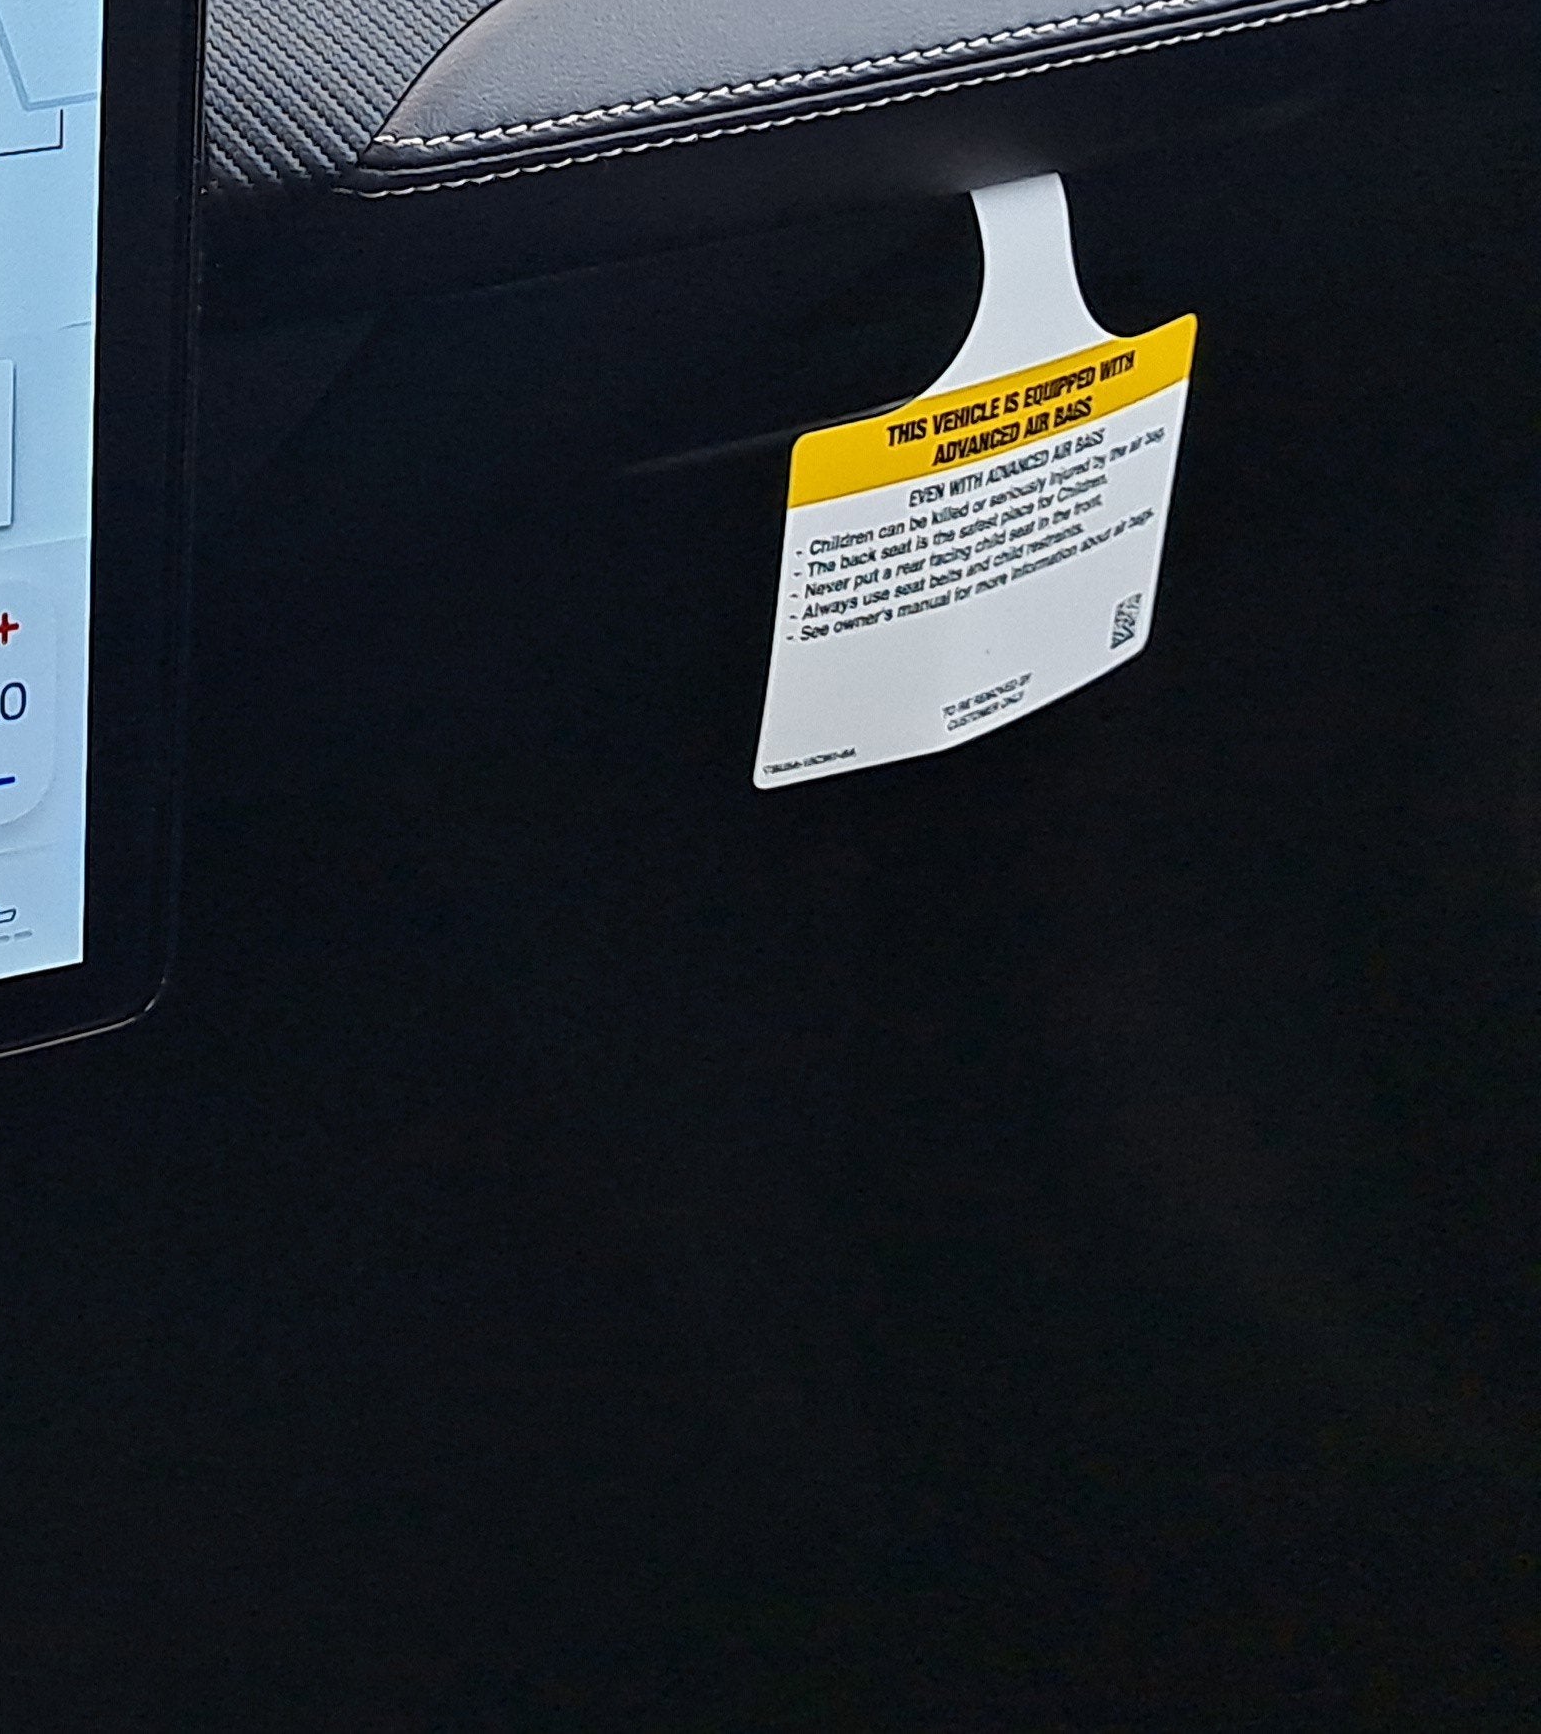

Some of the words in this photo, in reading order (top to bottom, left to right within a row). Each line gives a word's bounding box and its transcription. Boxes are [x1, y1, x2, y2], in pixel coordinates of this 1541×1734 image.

[887, 418, 927, 446] THIS
[932, 397, 1000, 434] VEHICLE
[1003, 391, 1019, 415] IS
[1023, 366, 1096, 408] EQUIPPED
[1100, 350, 1136, 382] WITH
[931, 421, 1020, 466] ADVANCED
[1023, 411, 1048, 438] AIR
[1053, 396, 1093, 428] BAGS
[909, 483, 945, 507] EVEN
[949, 472, 984, 497] WITH
[1051, 441, 1072, 462] AIR
[807, 560, 836, 577] The
[840, 548, 877, 569] back
[881, 538, 912, 560] seat
[916, 534, 928, 551] is
[933, 530, 955, 545] the
[959, 513, 998, 538] safest
[1001, 503, 1034, 526] place
[810, 529, 874, 555] Children
[878, 522, 905, 539] can
[909, 516, 927, 531] be
[931, 503, 968, 525] killed
[972, 499, 987, 513] or
[989, 477, 1047, 507] seriously
[802, 597, 858, 620] Always
[862, 588, 890, 606] use
[894, 577, 925, 598] seat
[929, 568, 962, 588] belts
[966, 555, 991, 577] and
[993, 544, 1024, 566] child
[804, 577, 851, 598] Never
[853, 570, 879, 591] put
[882, 568, 892, 580] a
[896, 558, 926, 576] rear
[929, 545, 971, 567] facing
[974, 530, 1006, 553] child
[1009, 520, 1035, 541] seat
[799, 624, 829, 641] See
[833, 607, 893, 633] owner's
[897, 590, 951, 618] manual
[954, 584, 972, 602] for
[975, 571, 1008, 594] more
